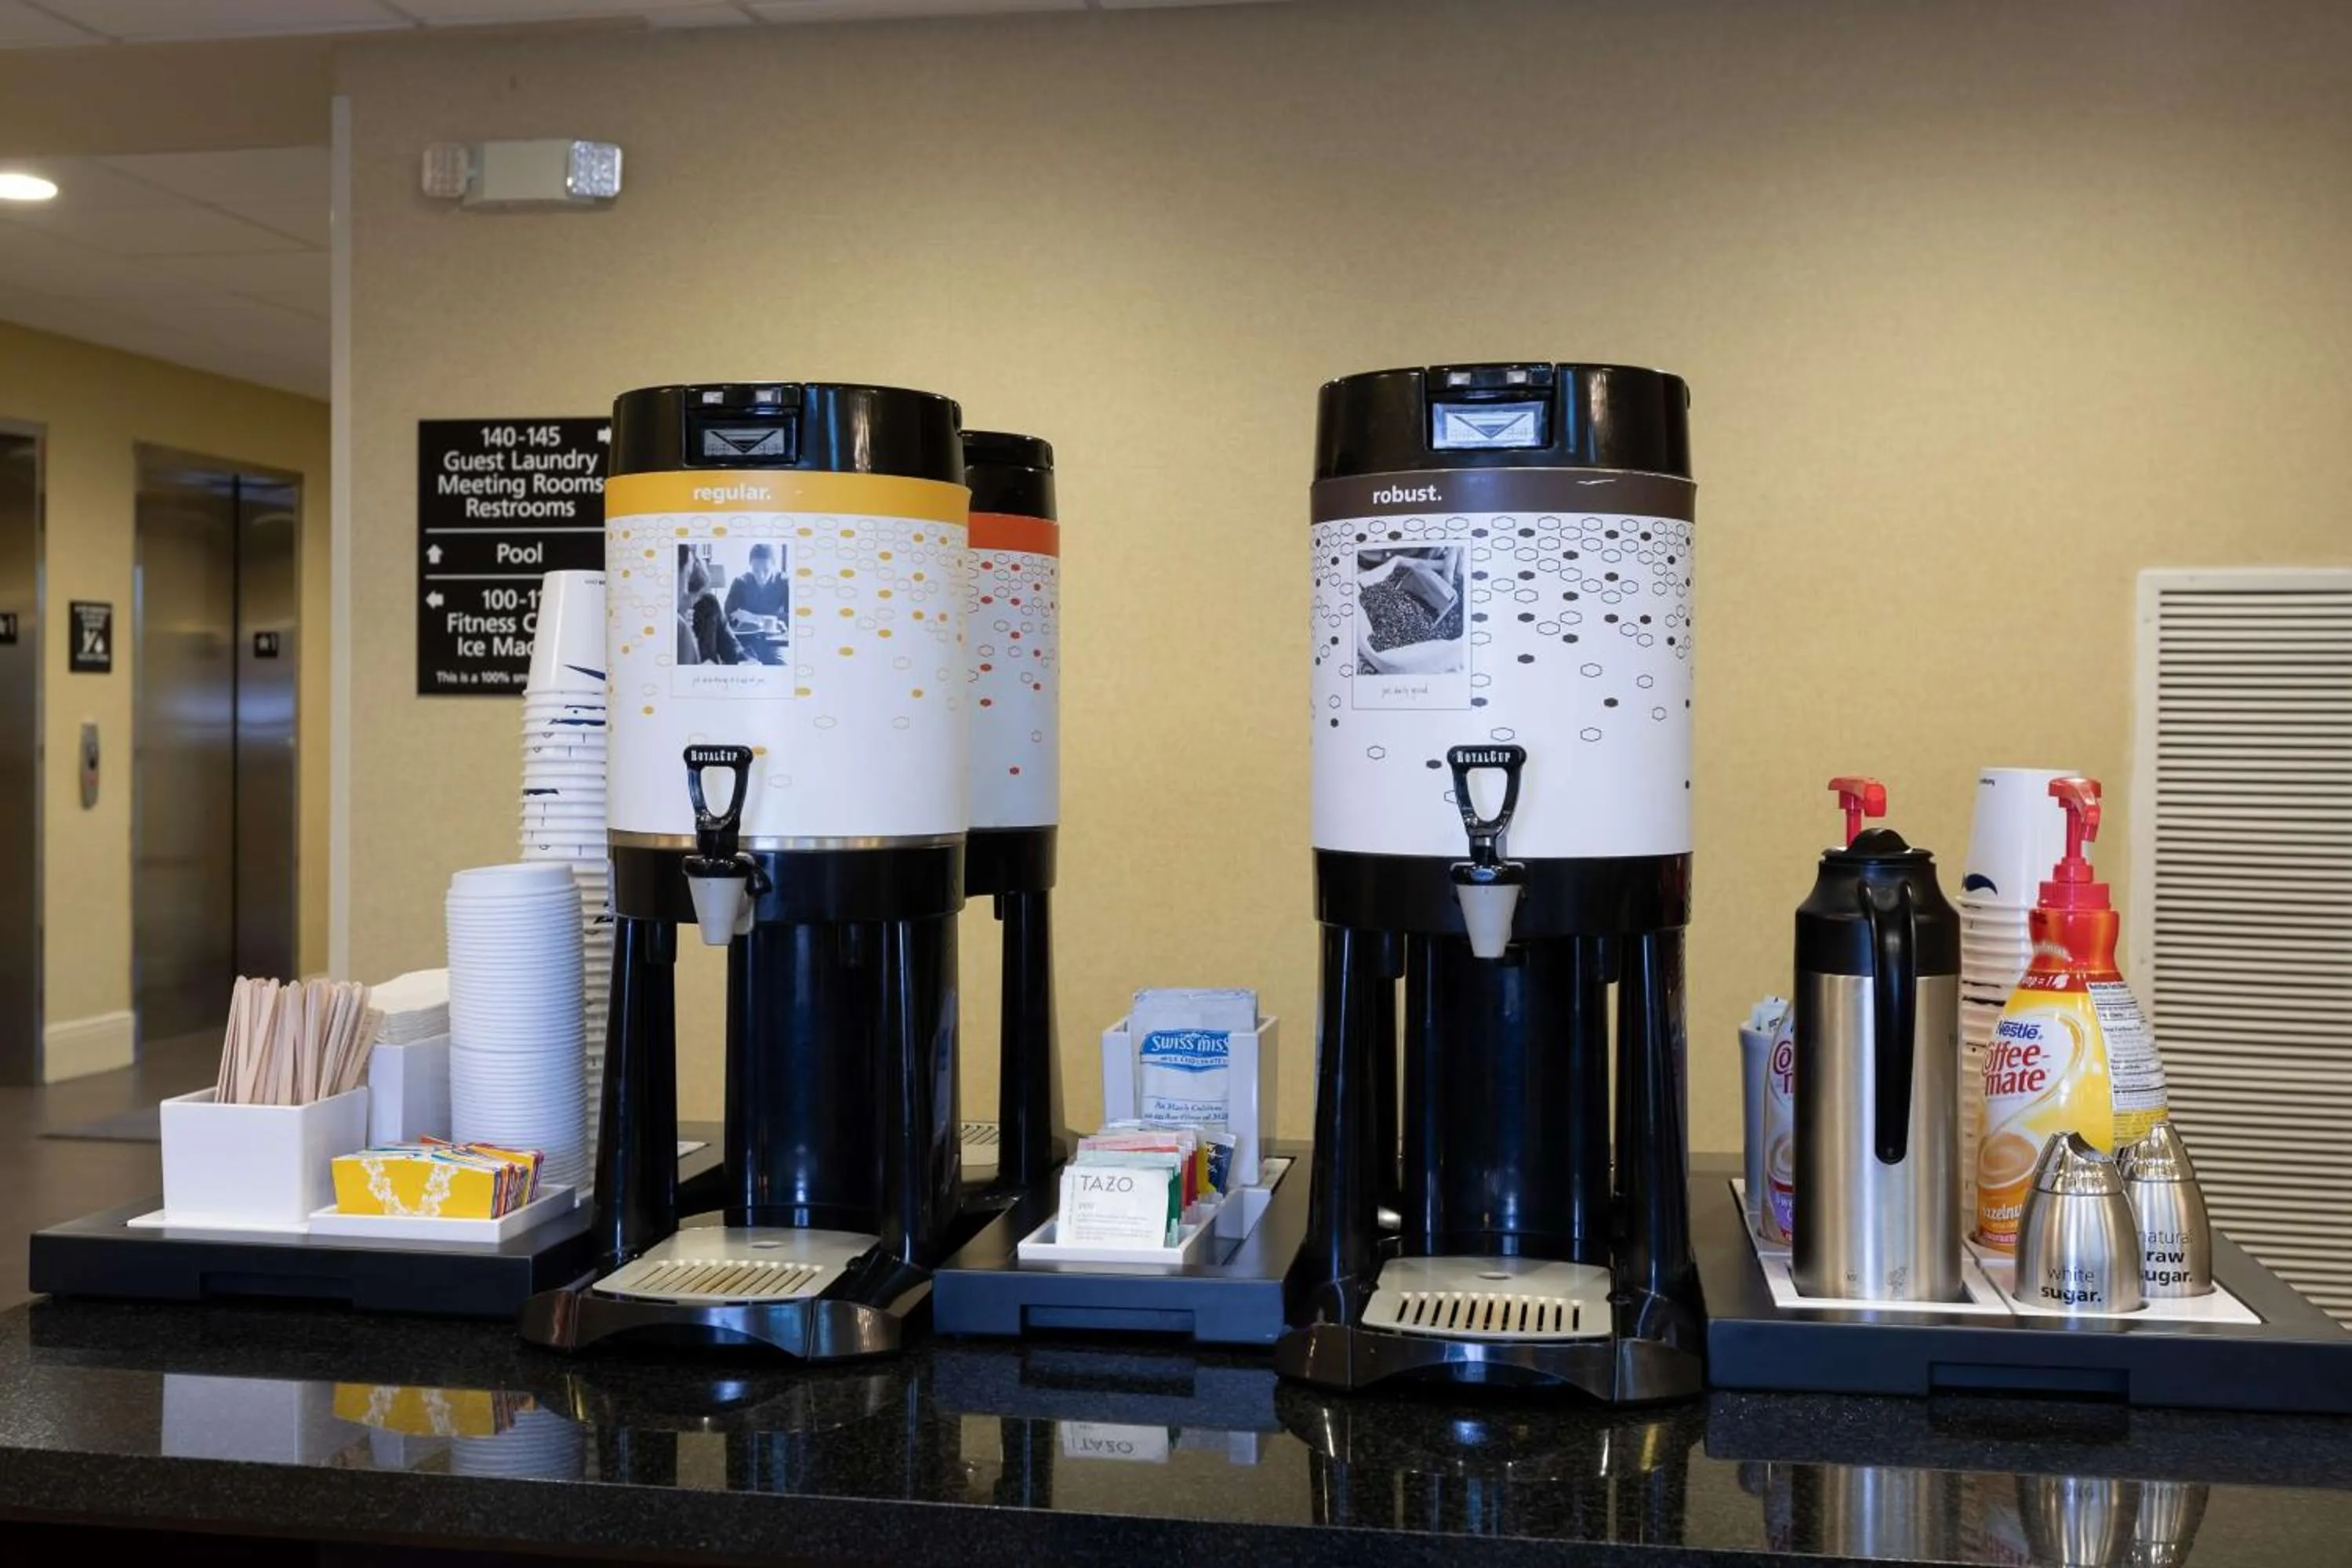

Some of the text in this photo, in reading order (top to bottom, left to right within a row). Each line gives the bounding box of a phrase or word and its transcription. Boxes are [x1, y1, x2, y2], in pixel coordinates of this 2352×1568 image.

[481, 426, 561, 448] 140-145
[443, 448, 598, 474] Guest Laundry
[437, 473, 604, 499] Meeting Rooms
[693, 483, 771, 504] regular.
[1373, 485, 1443, 504] robust.
[466, 497, 575, 517] Restrooms
[497, 541, 543, 564] Pool
[447, 612, 517, 633] Fitness
[457, 636, 534, 657] Ice Mac
[436, 670, 458, 683] This
[459, 671, 468, 683] is
[470, 673, 478, 683] a
[1985, 1068, 2045, 1097] mate
[1080, 1175, 1134, 1192] TAZO
[2146, 1250, 2185, 1264] raw
[2047, 1265, 2095, 1283] white
[2041, 1287, 2102, 1305] sugar.
